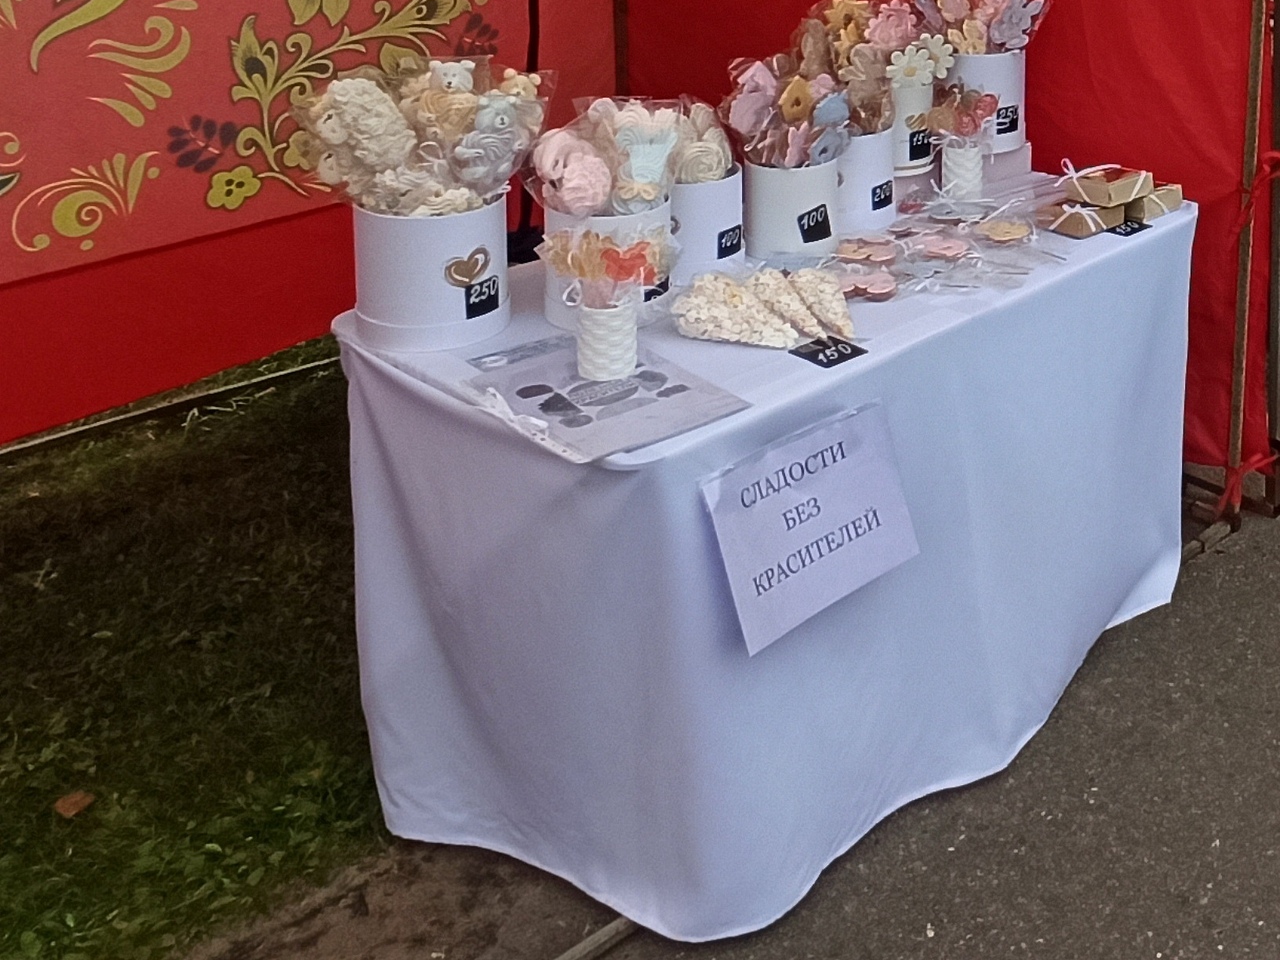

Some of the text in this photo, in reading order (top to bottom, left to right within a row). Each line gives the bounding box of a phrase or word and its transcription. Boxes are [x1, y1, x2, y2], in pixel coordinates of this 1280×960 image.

[801, 207, 826, 230] 100
[1116, 220, 1140, 234] 150
[721, 228, 740, 248] 100
[469, 276, 499, 304] 250
[817, 343, 852, 364] 150
[740, 441, 847, 508] СЛАДОСТИ
[782, 497, 821, 531] БЕЗ
[752, 507, 882, 596] КРАСИТЕЛЕЙ
